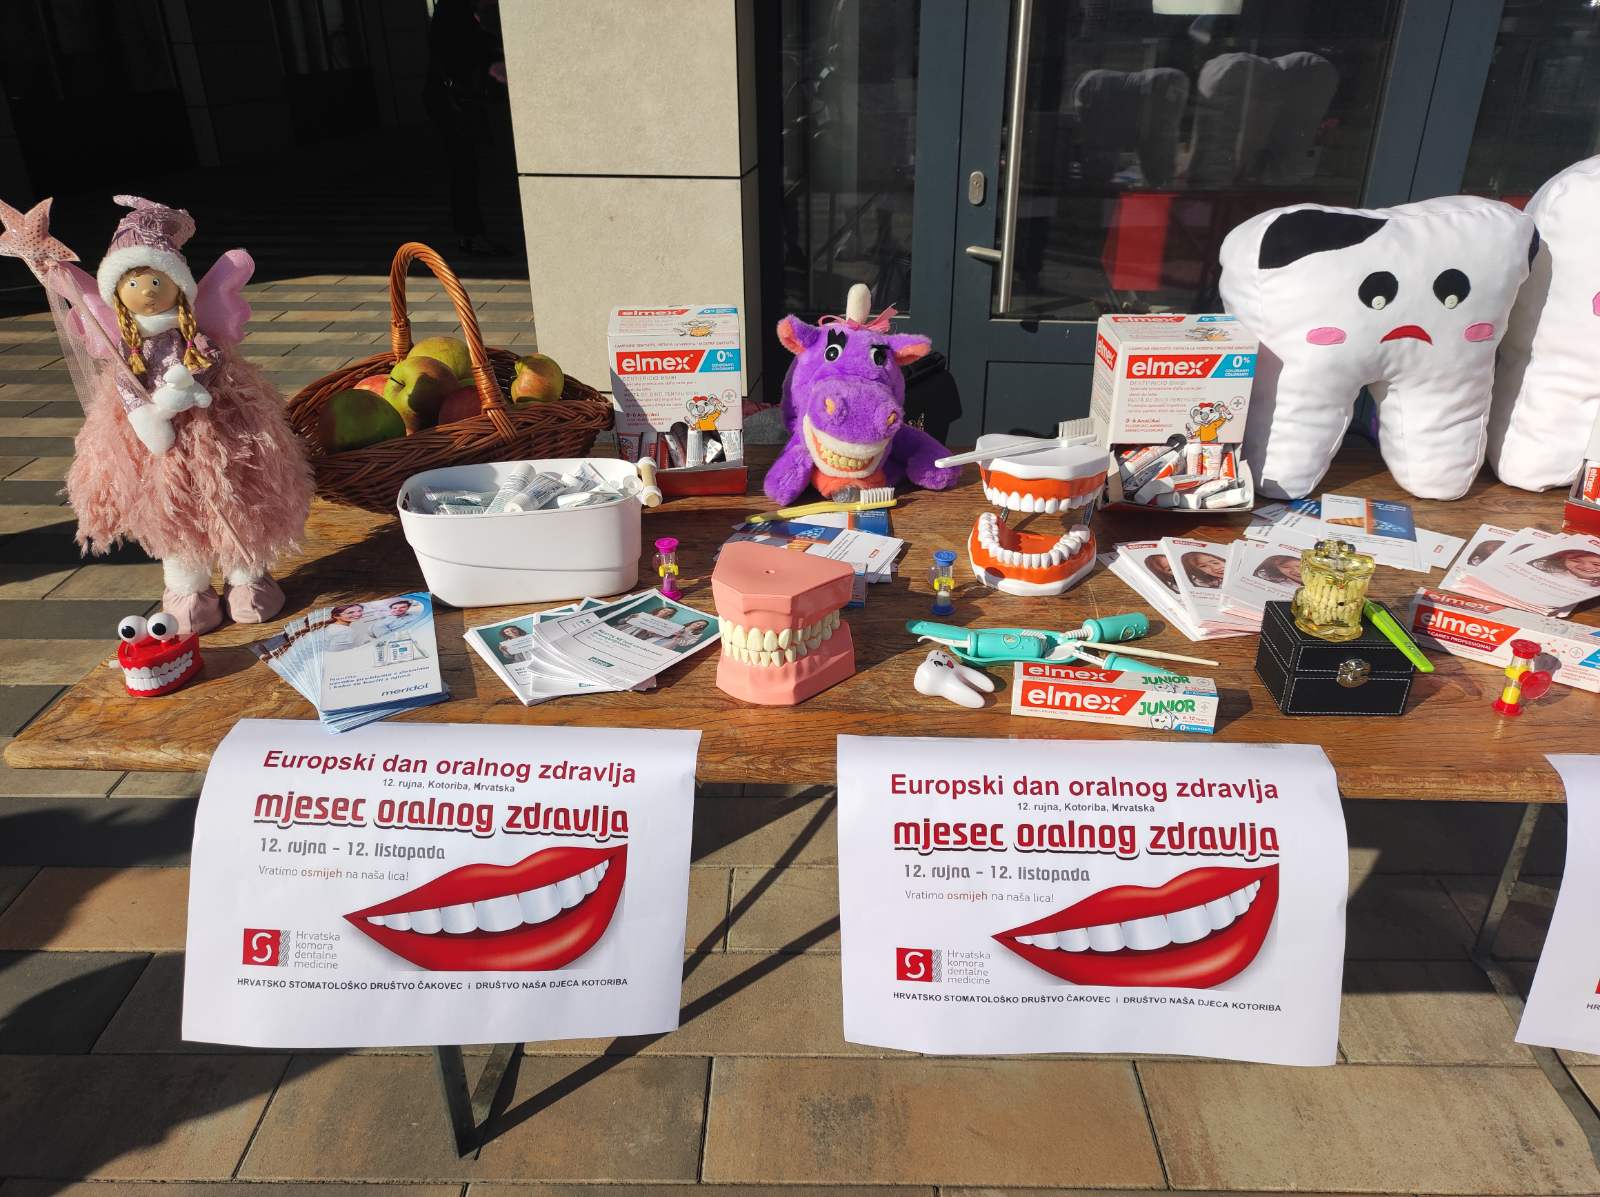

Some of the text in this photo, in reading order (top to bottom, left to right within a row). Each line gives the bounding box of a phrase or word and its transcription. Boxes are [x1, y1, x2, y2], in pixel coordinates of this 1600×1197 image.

[621, 353, 691, 372] elmex
[716, 350, 733, 363] 0%
[1232, 355, 1250, 368] 0%
[1131, 357, 1203, 376] elmex
[1429, 593, 1494, 610] elmex
[1420, 611, 1501, 642] elmex
[1028, 665, 1191, 685] elmex JUNIOR
[381, 682, 429, 697] meridol
[1027, 685, 1196, 716] elmex JUNIOR
[263, 750, 636, 788] Europski dan oralnog zdravlja
[383, 779, 395, 787] 12.
[399, 779, 425, 789] rujna,
[428, 780, 471, 791] Kotoriba,
[891, 774, 1279, 804] Europski dan oralnog zdravlja
[254, 791, 629, 839] mjesec oralnog zdravlja
[1017, 802, 1031, 811] 12.
[1033, 802, 1062, 813] rujna,
[1064, 803, 1109, 812] Kotoriba,
[894, 818, 1280, 858] mjesec oralnog zdravlja
[260, 837, 282, 853] 12.
[288, 839, 326, 856] rujna
[347, 841, 369, 857] 12.
[374, 842, 445, 861] listopada
[258, 865, 409, 881] Vratimo osmijeh na naša lica!
[904, 864, 926, 878] 12.
[931, 864, 970, 880] rujna
[990, 865, 1012, 879] 12.
[1018, 866, 1090, 883] listopada
[905, 889, 1054, 903] Vratimo osmijeh na naša lica!
[296, 930, 341, 942] Hrvatska
[295, 941, 333, 951] komora
[294, 950, 337, 960] dentalne
[947, 950, 991, 960] Hrvatska
[294, 959, 339, 969] medicine
[947, 959, 985, 968] komora
[947, 967, 989, 977] dentalne
[237, 977, 286, 988] HRVATSKO
[288, 979, 368, 990] STOMATOLOŠKO
[370, 981, 415, 990] DRUŠTVO
[417, 980, 463, 990] ČAKOVEC
[475, 981, 520, 990] DRUŠTVO
[522, 980, 547, 989] NAŠA
[549, 979, 579, 989] DJECA
[581, 978, 628, 988] KOTORIBA
[947, 976, 990, 985] medicine
[893, 991, 942, 1002] HRVATSKO
[944, 993, 1019, 1004] STOMATOLOŠKO
[1021, 994, 1064, 1004] DRUŠTVO
[1066, 994, 1111, 1004] ČAKOVEC
[1123, 994, 1167, 1004] DRUŠTVO
[1169, 996, 1195, 1006] NAŠA
[1197, 998, 1229, 1009] DJECA
[1231, 1002, 1282, 1012] KOTORIBA
